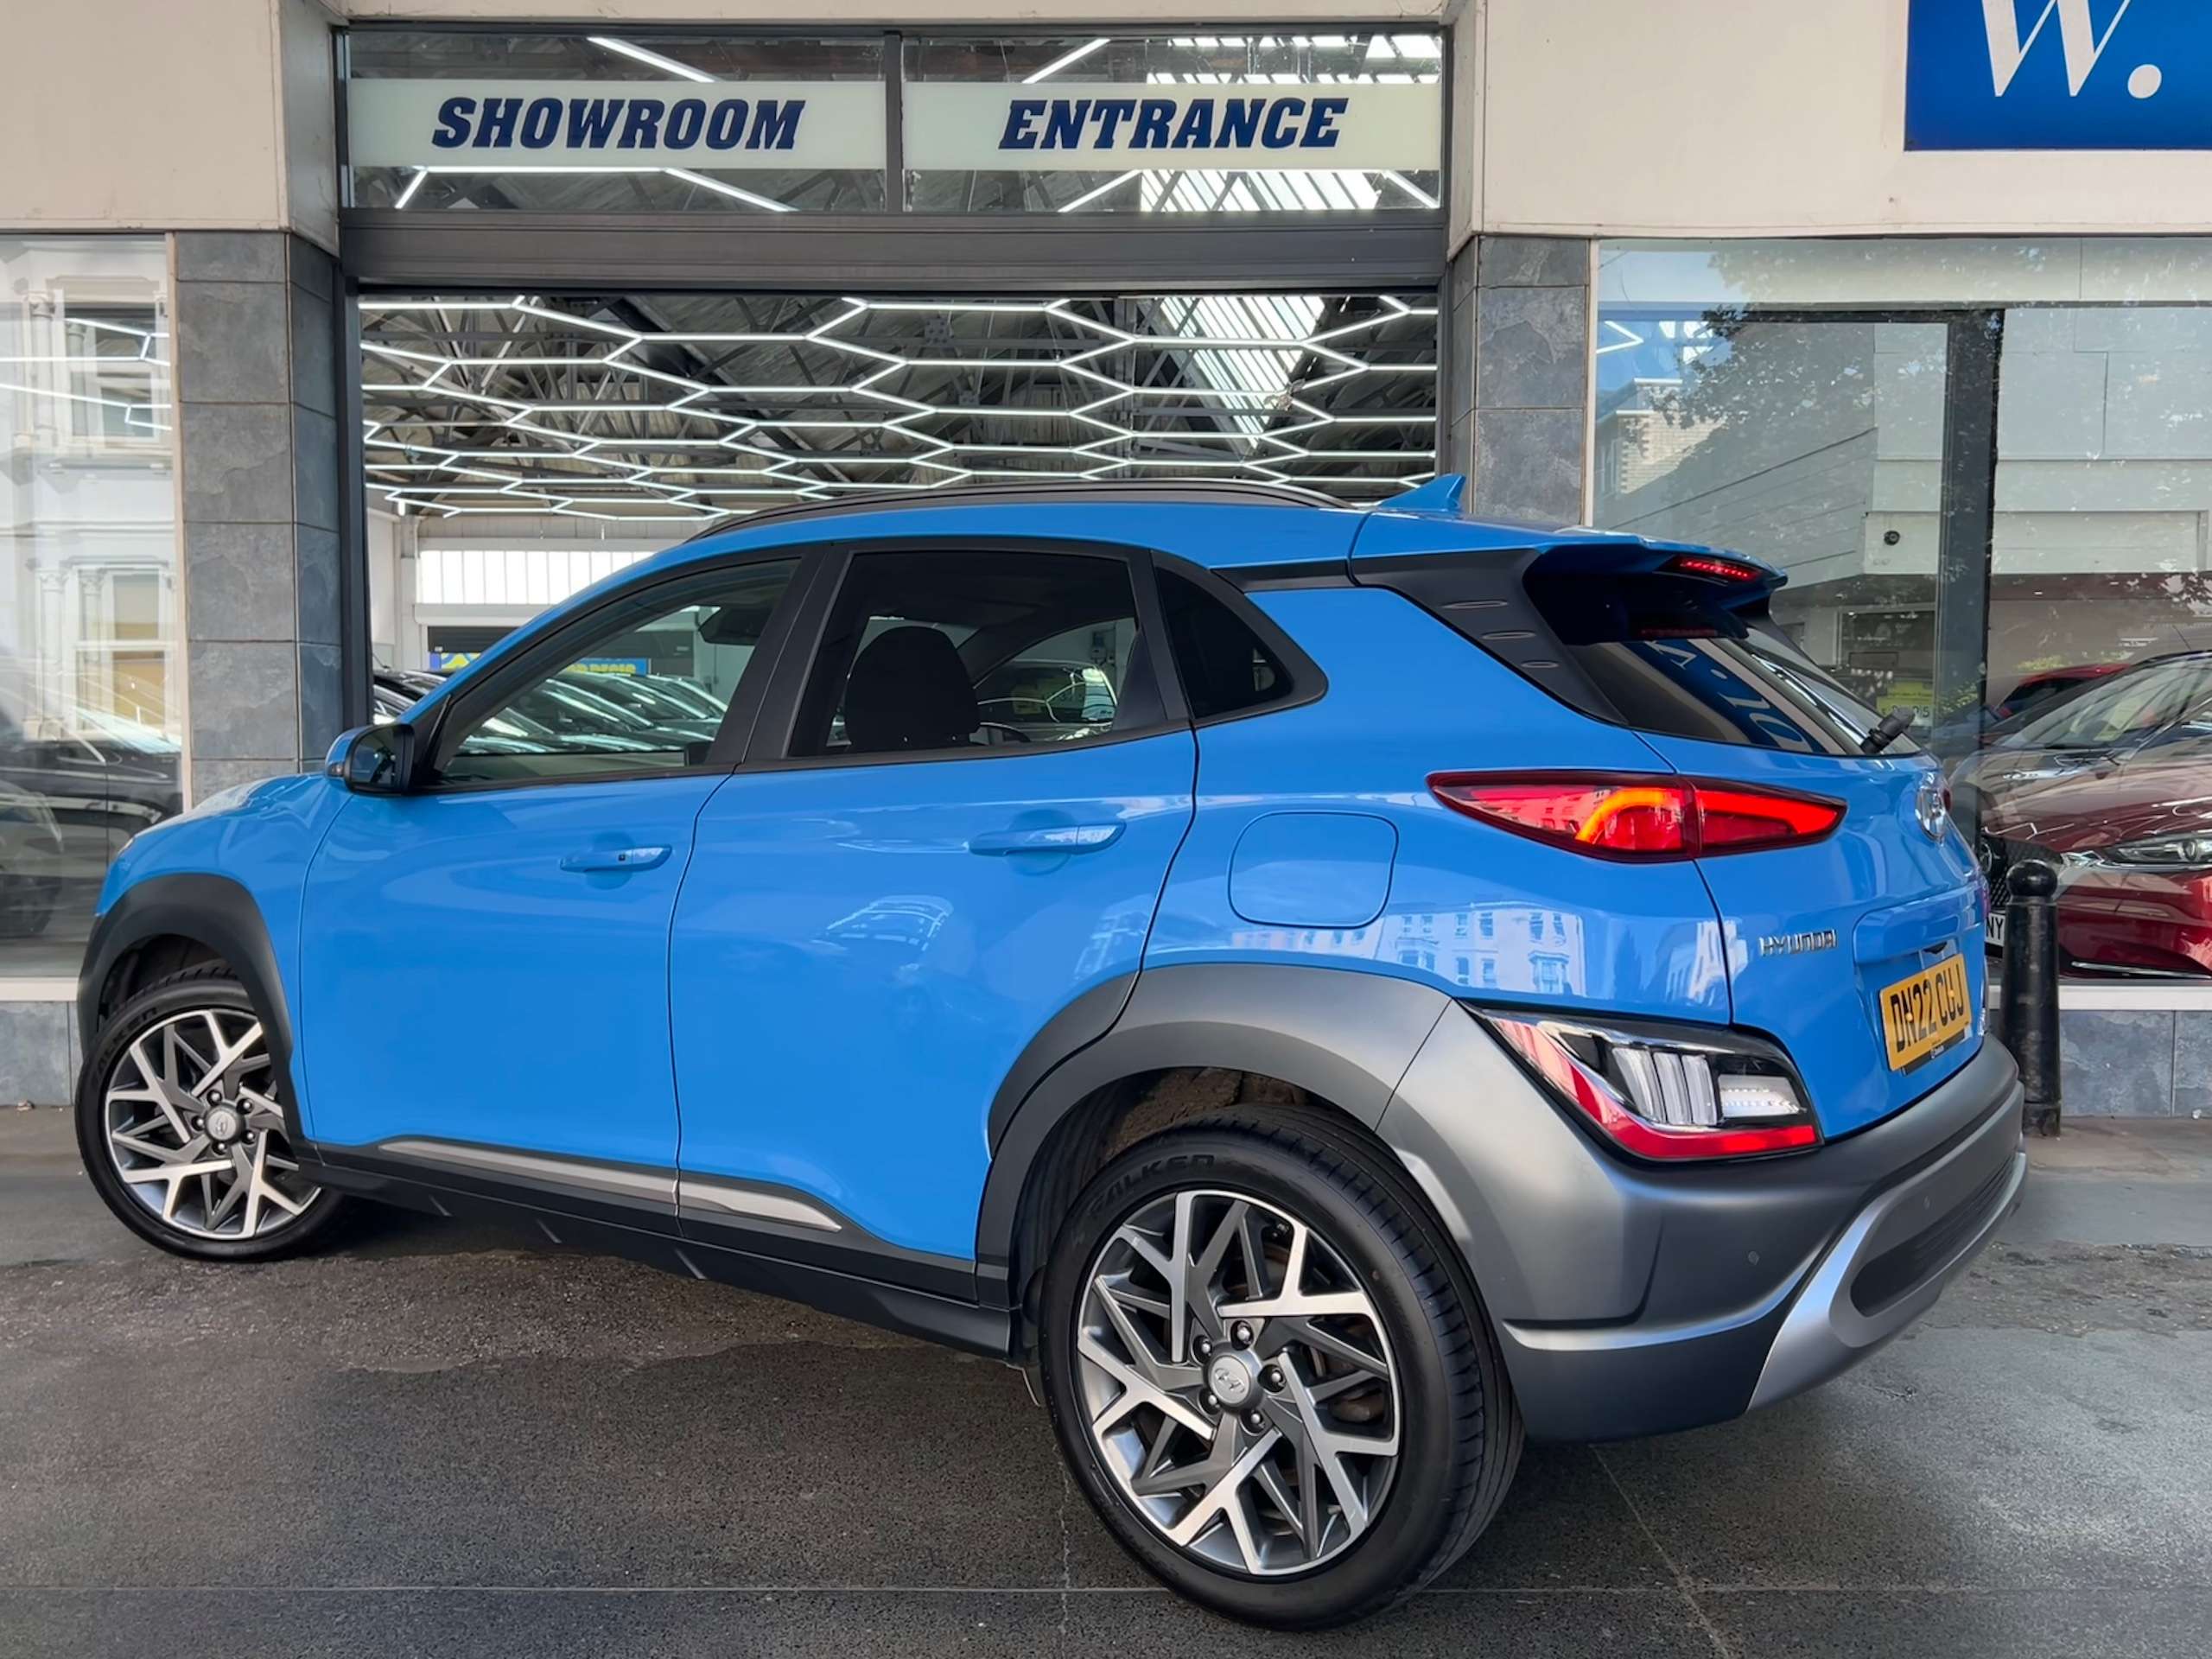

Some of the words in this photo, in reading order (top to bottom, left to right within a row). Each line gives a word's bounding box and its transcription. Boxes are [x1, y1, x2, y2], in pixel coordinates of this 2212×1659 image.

[431, 97, 807, 150] SHOWROOM
[998, 97, 1350, 150] ENTRANCE
[1759, 929, 1837, 957] HYUNDAI
[1889, 978, 1937, 1052] DN22
